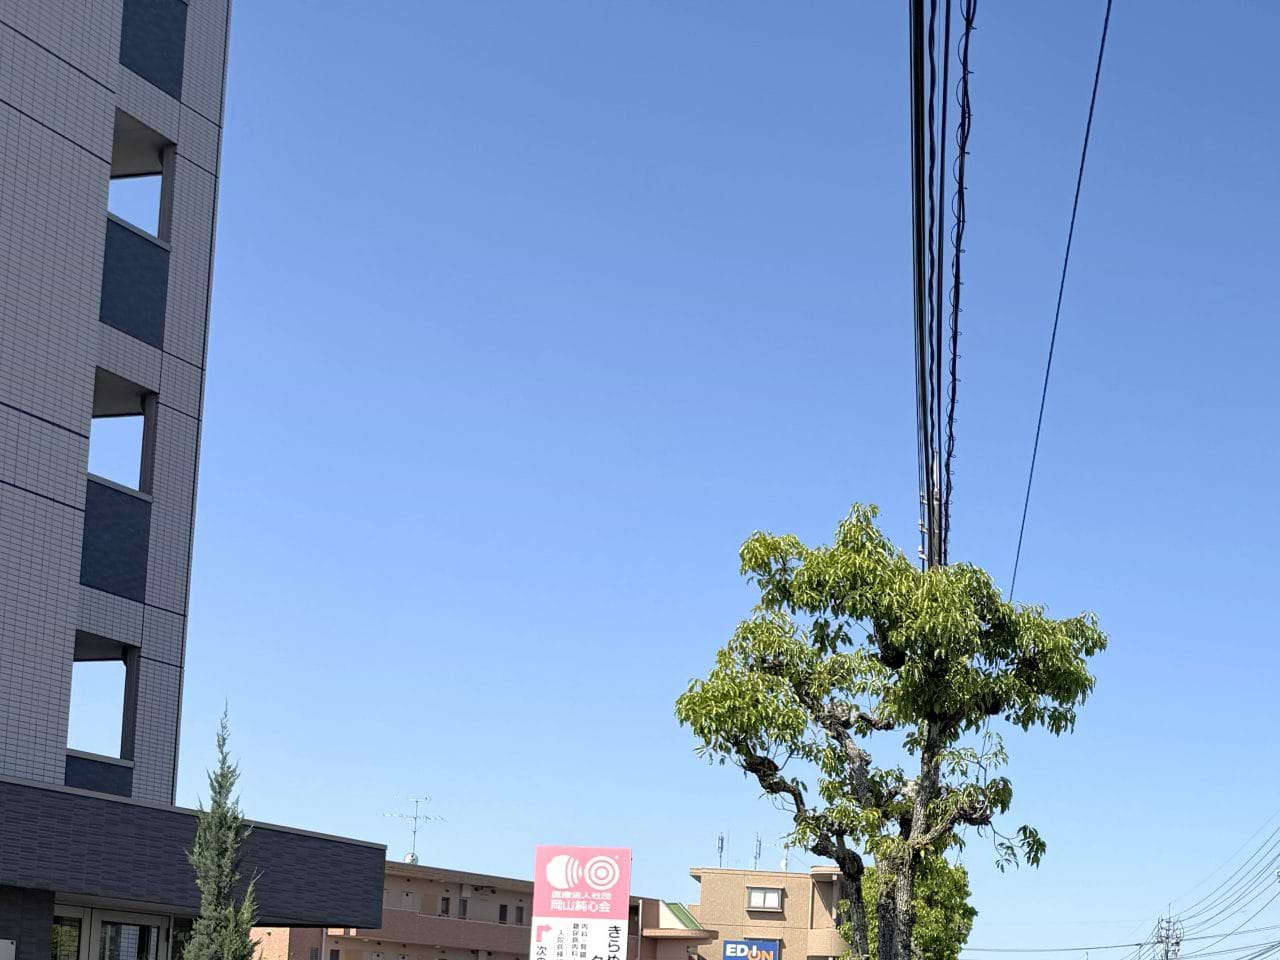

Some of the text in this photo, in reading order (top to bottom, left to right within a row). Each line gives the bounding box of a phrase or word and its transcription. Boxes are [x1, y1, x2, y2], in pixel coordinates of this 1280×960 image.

[551, 890, 612, 900] 医療法人社団
